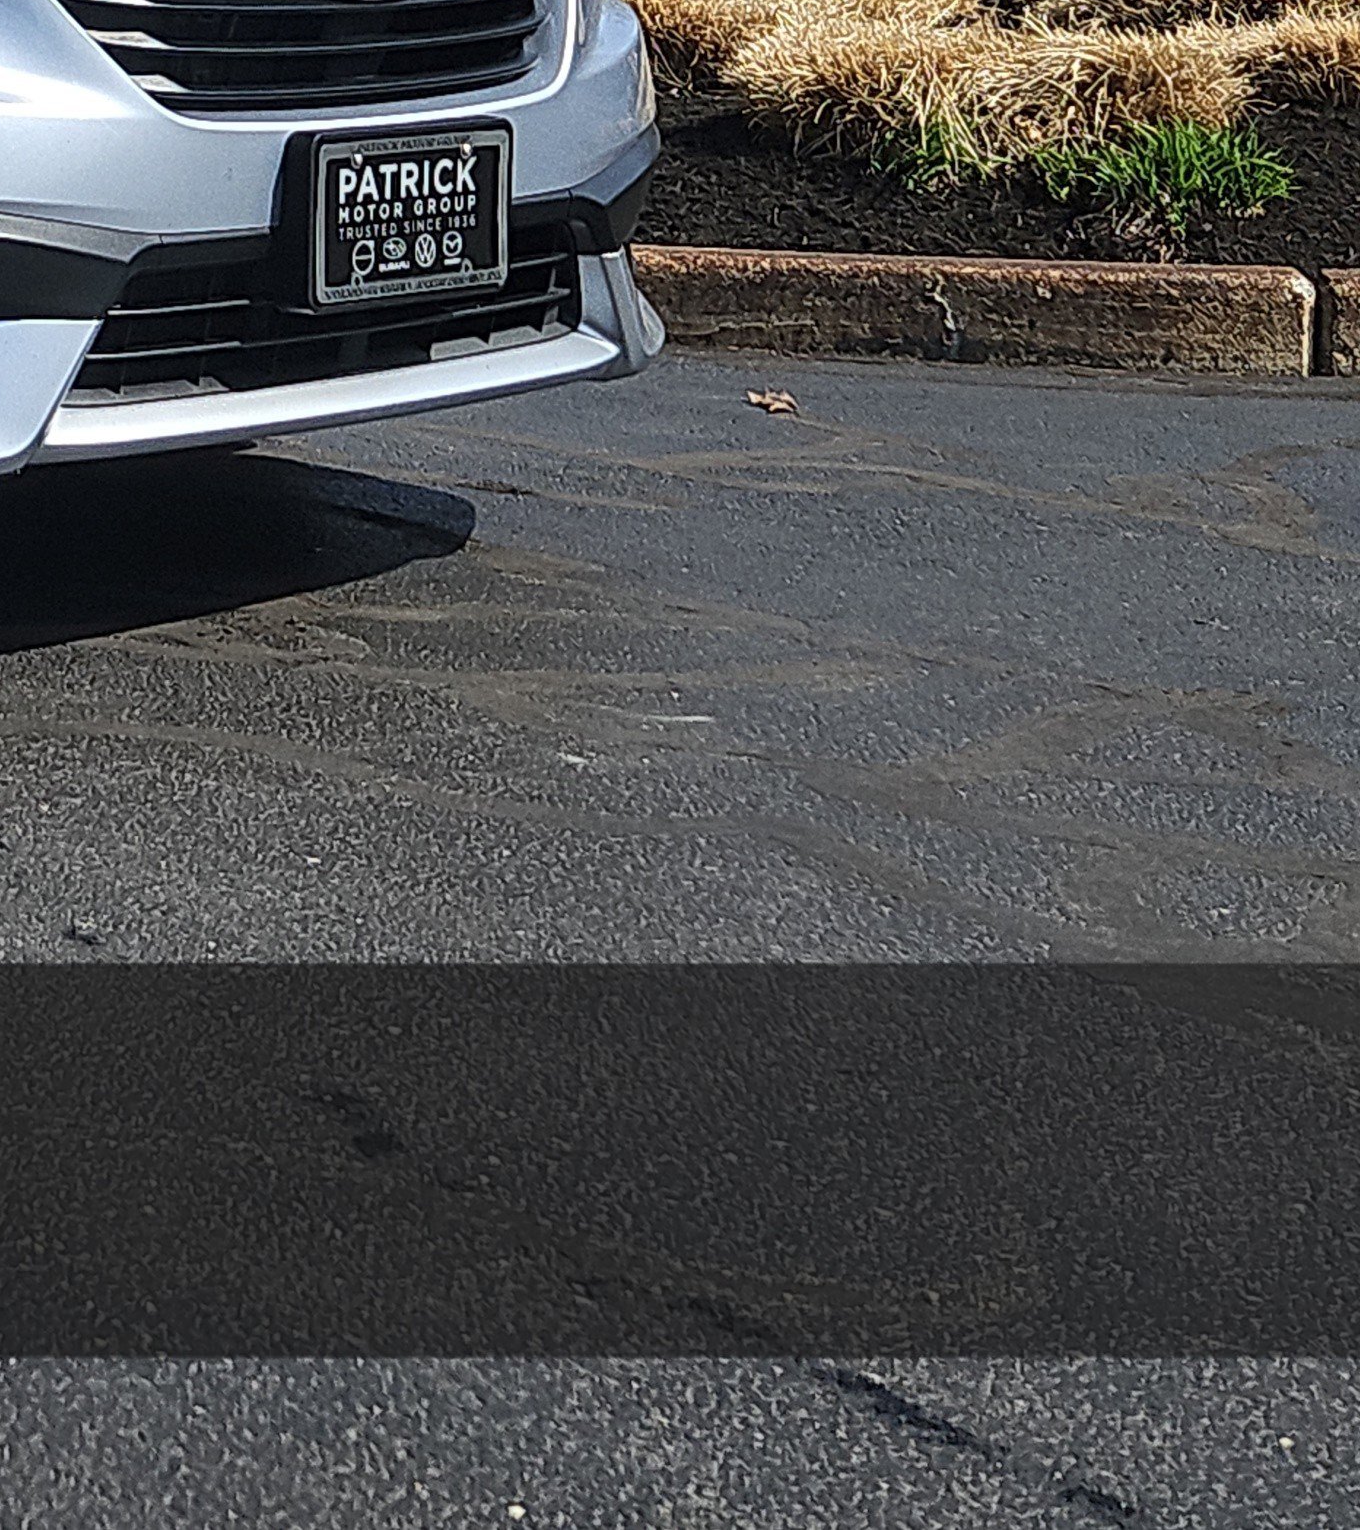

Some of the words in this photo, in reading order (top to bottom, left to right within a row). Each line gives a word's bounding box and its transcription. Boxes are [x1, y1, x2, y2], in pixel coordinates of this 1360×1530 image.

[338, 156, 478, 205] PATRICK
[337, 202, 403, 225] MOTOR
[413, 195, 477, 216] GROUP
[338, 223, 398, 241] TRUSTED
[403, 217, 442, 234] SINCE
